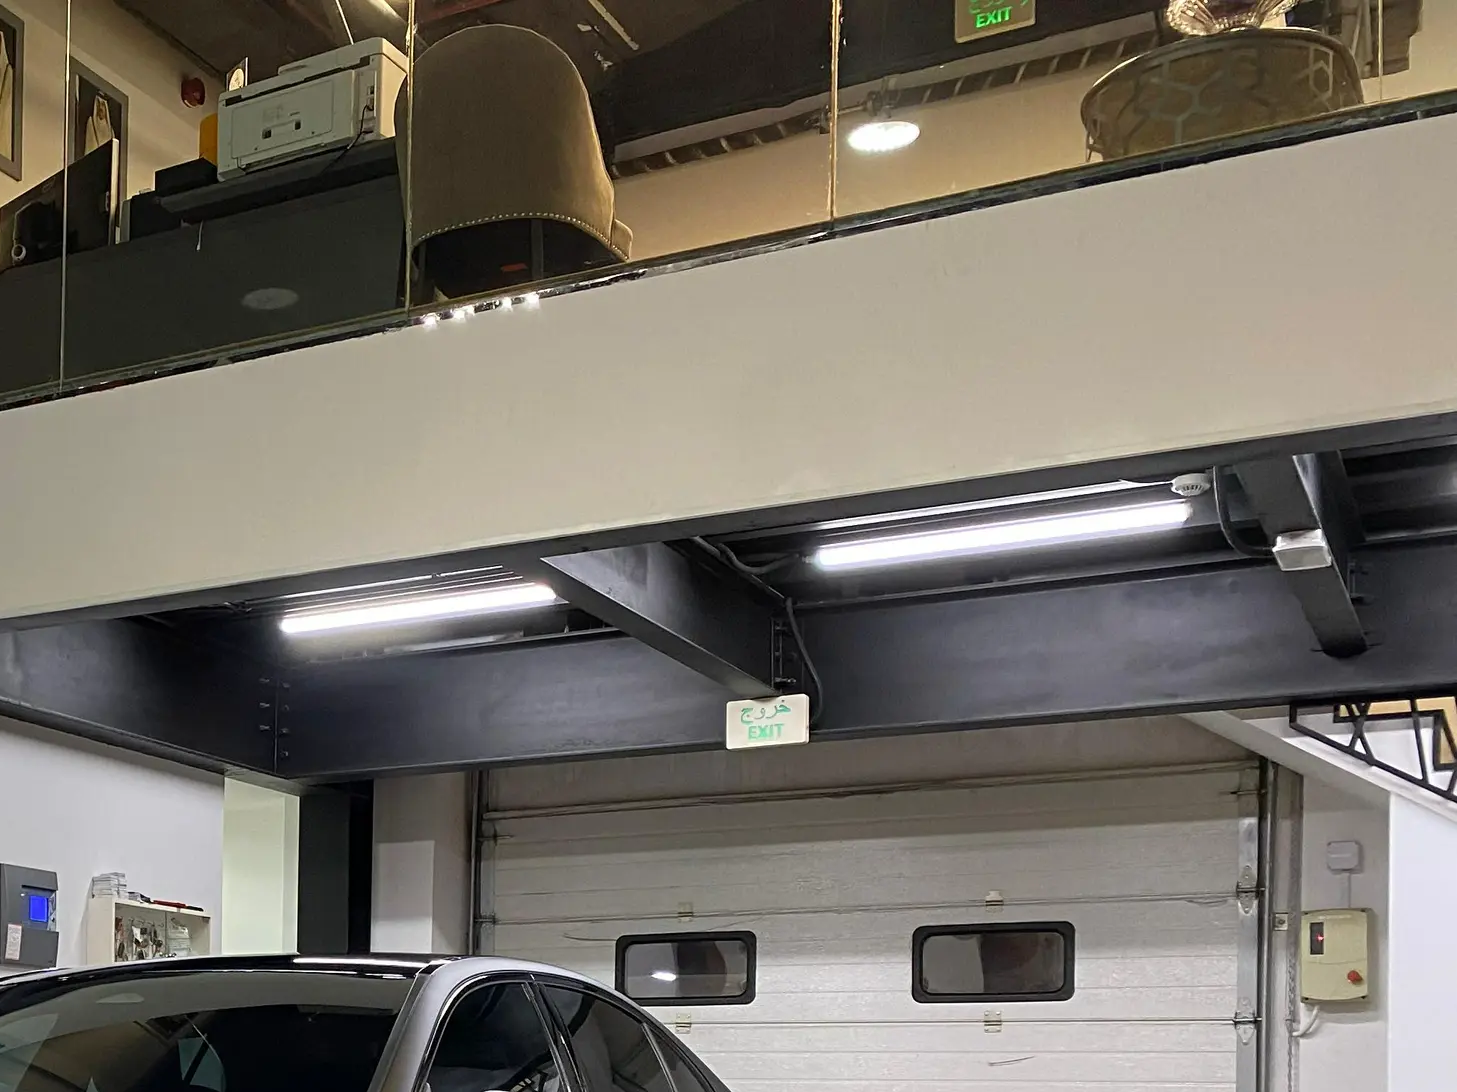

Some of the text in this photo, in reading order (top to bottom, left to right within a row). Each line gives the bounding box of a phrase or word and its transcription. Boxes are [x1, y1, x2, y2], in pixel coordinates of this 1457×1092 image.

[976, 6, 1012, 28] EXIT
[740, 699, 791, 724] خروج
[748, 723, 784, 740] EXIT
